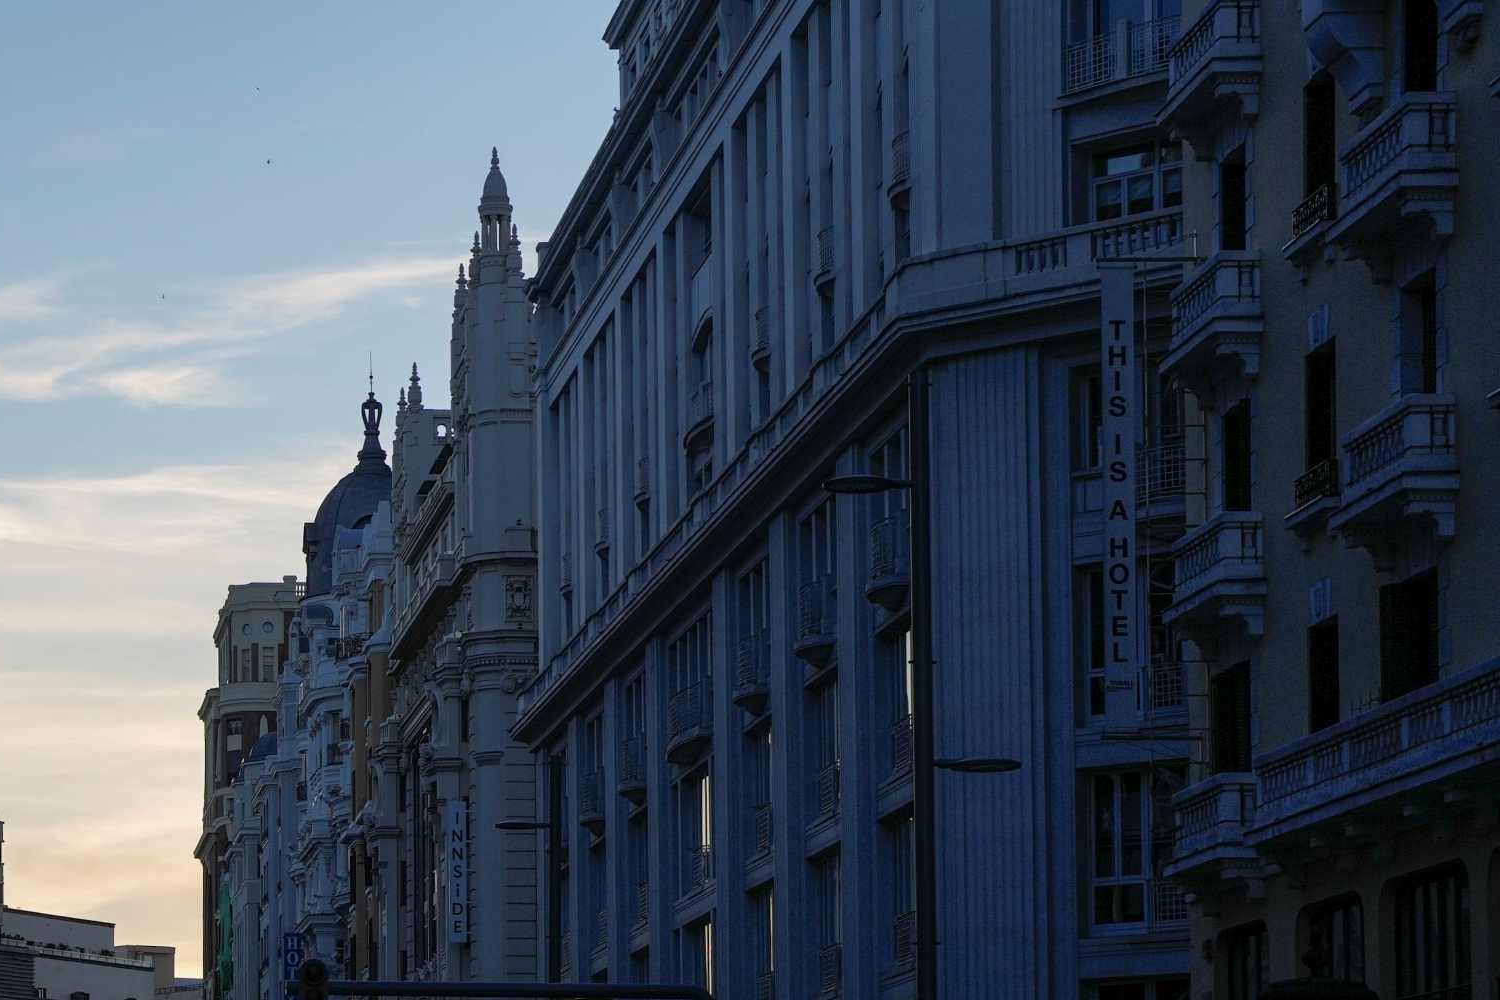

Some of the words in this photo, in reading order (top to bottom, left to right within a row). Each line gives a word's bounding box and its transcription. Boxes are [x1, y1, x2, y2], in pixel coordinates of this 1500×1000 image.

[1109, 319, 1127, 418] THIS
[1109, 434, 1128, 483] IS
[1109, 499, 1129, 521] A
[1109, 537, 1130, 664] HOTEL
